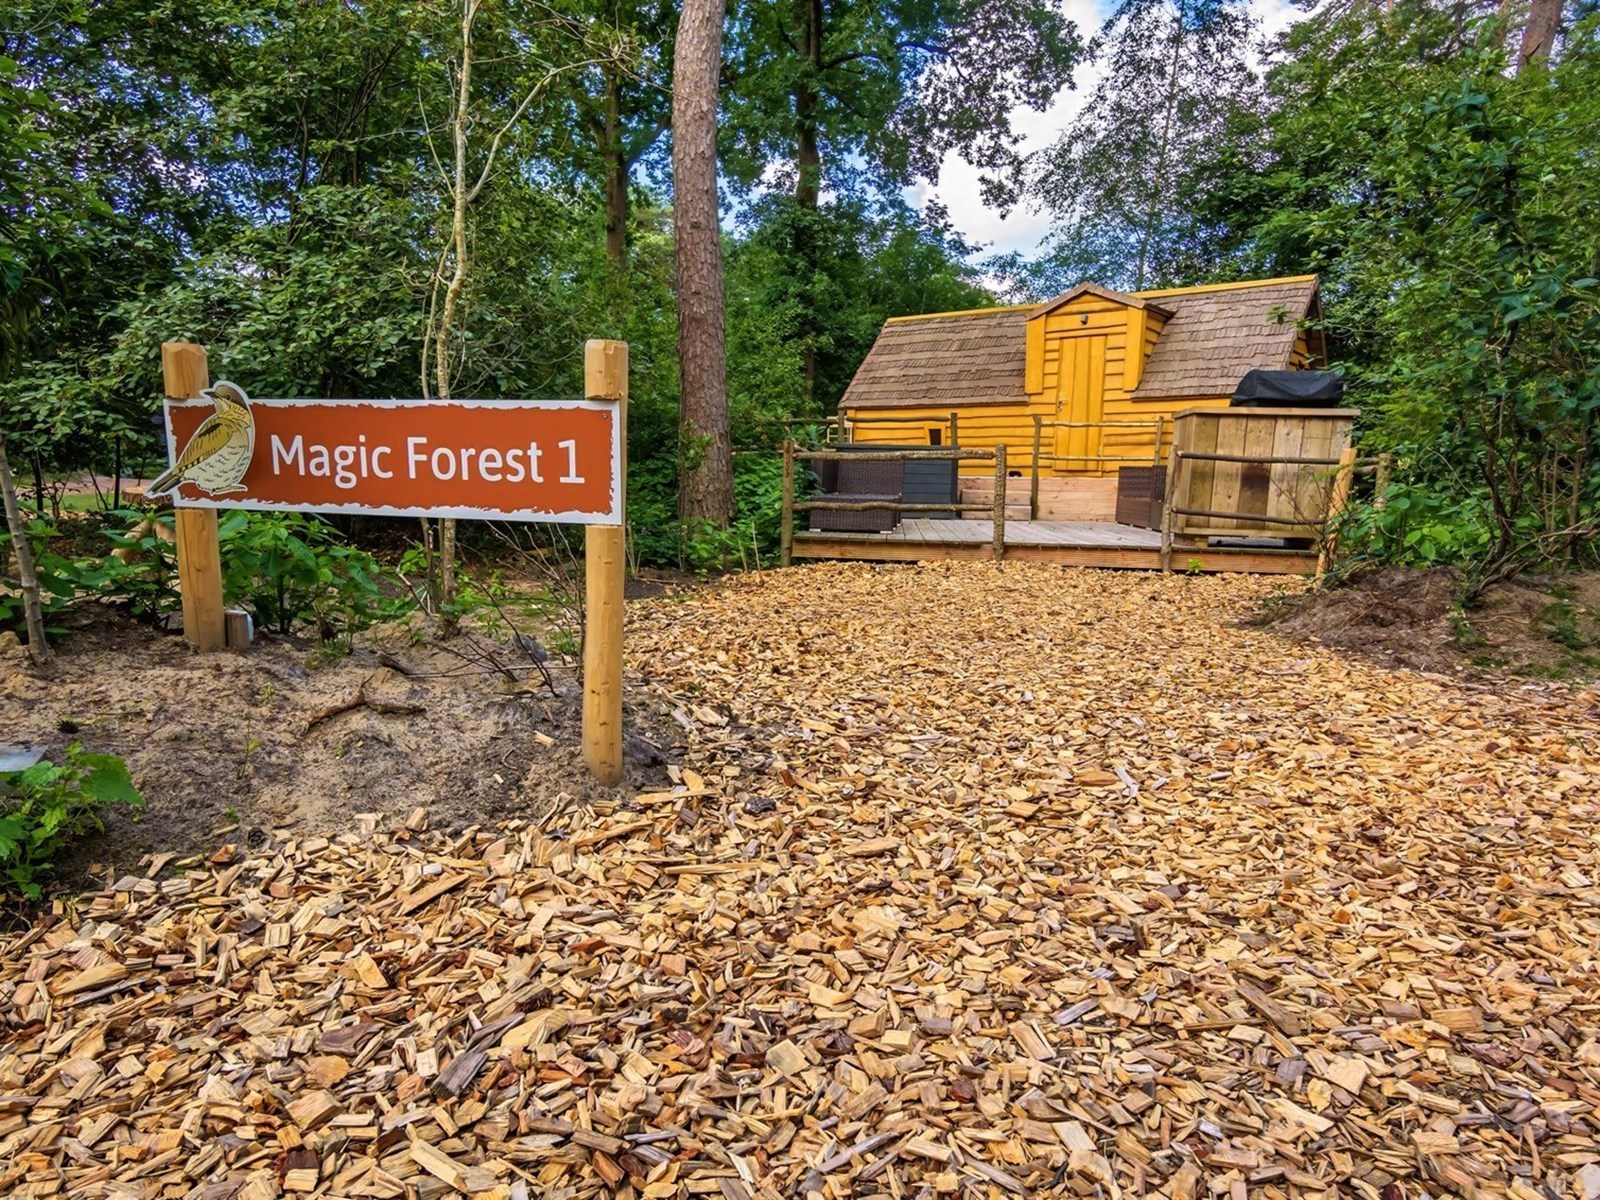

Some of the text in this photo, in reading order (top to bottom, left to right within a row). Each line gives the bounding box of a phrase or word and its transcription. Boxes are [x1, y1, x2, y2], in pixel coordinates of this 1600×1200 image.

[270, 434, 586, 490] Magic Forest 1
